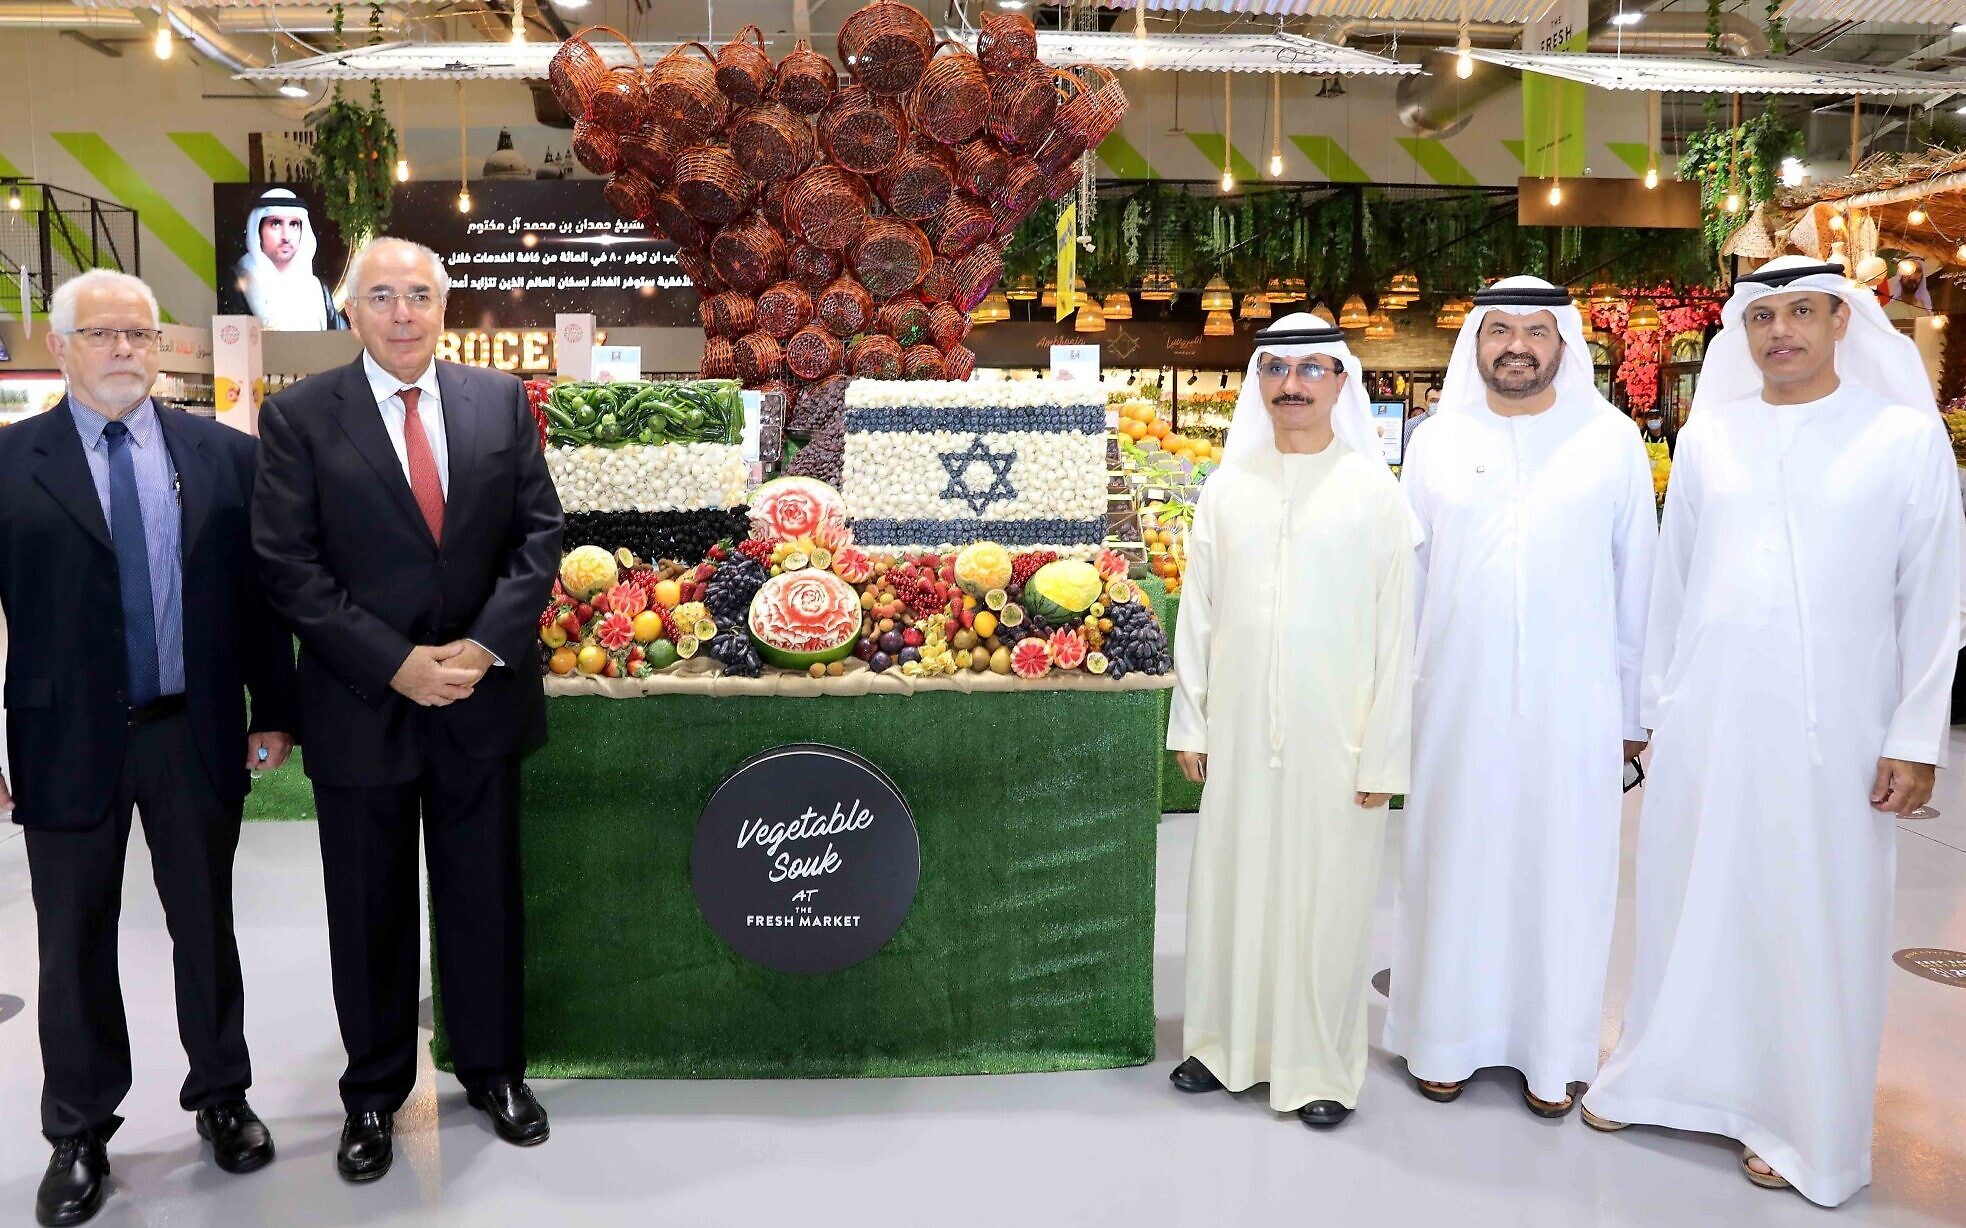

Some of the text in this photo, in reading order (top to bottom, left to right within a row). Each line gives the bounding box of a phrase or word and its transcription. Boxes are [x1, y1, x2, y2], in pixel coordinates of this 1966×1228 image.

[1541, 24, 1572, 52] FRESH
[467, 219, 505, 234] مكتوم
[508, 217, 521, 234] آل
[523, 222, 556, 230] محمد
[559, 221, 572, 233] بن
[575, 218, 611, 233] حمدان
[448, 251, 472, 266] خلال
[473, 251, 515, 263] الخدمات
[516, 251, 540, 263] كافة
[542, 253, 558, 265] من
[590, 251, 608, 267] في
[526, 275, 556, 290] العالم
[736, 799, 874, 856] Vegetable
[768, 842, 842, 882] Souk
[791, 889, 819, 902] AT
[746, 915, 861, 927] FRESH MARKET
